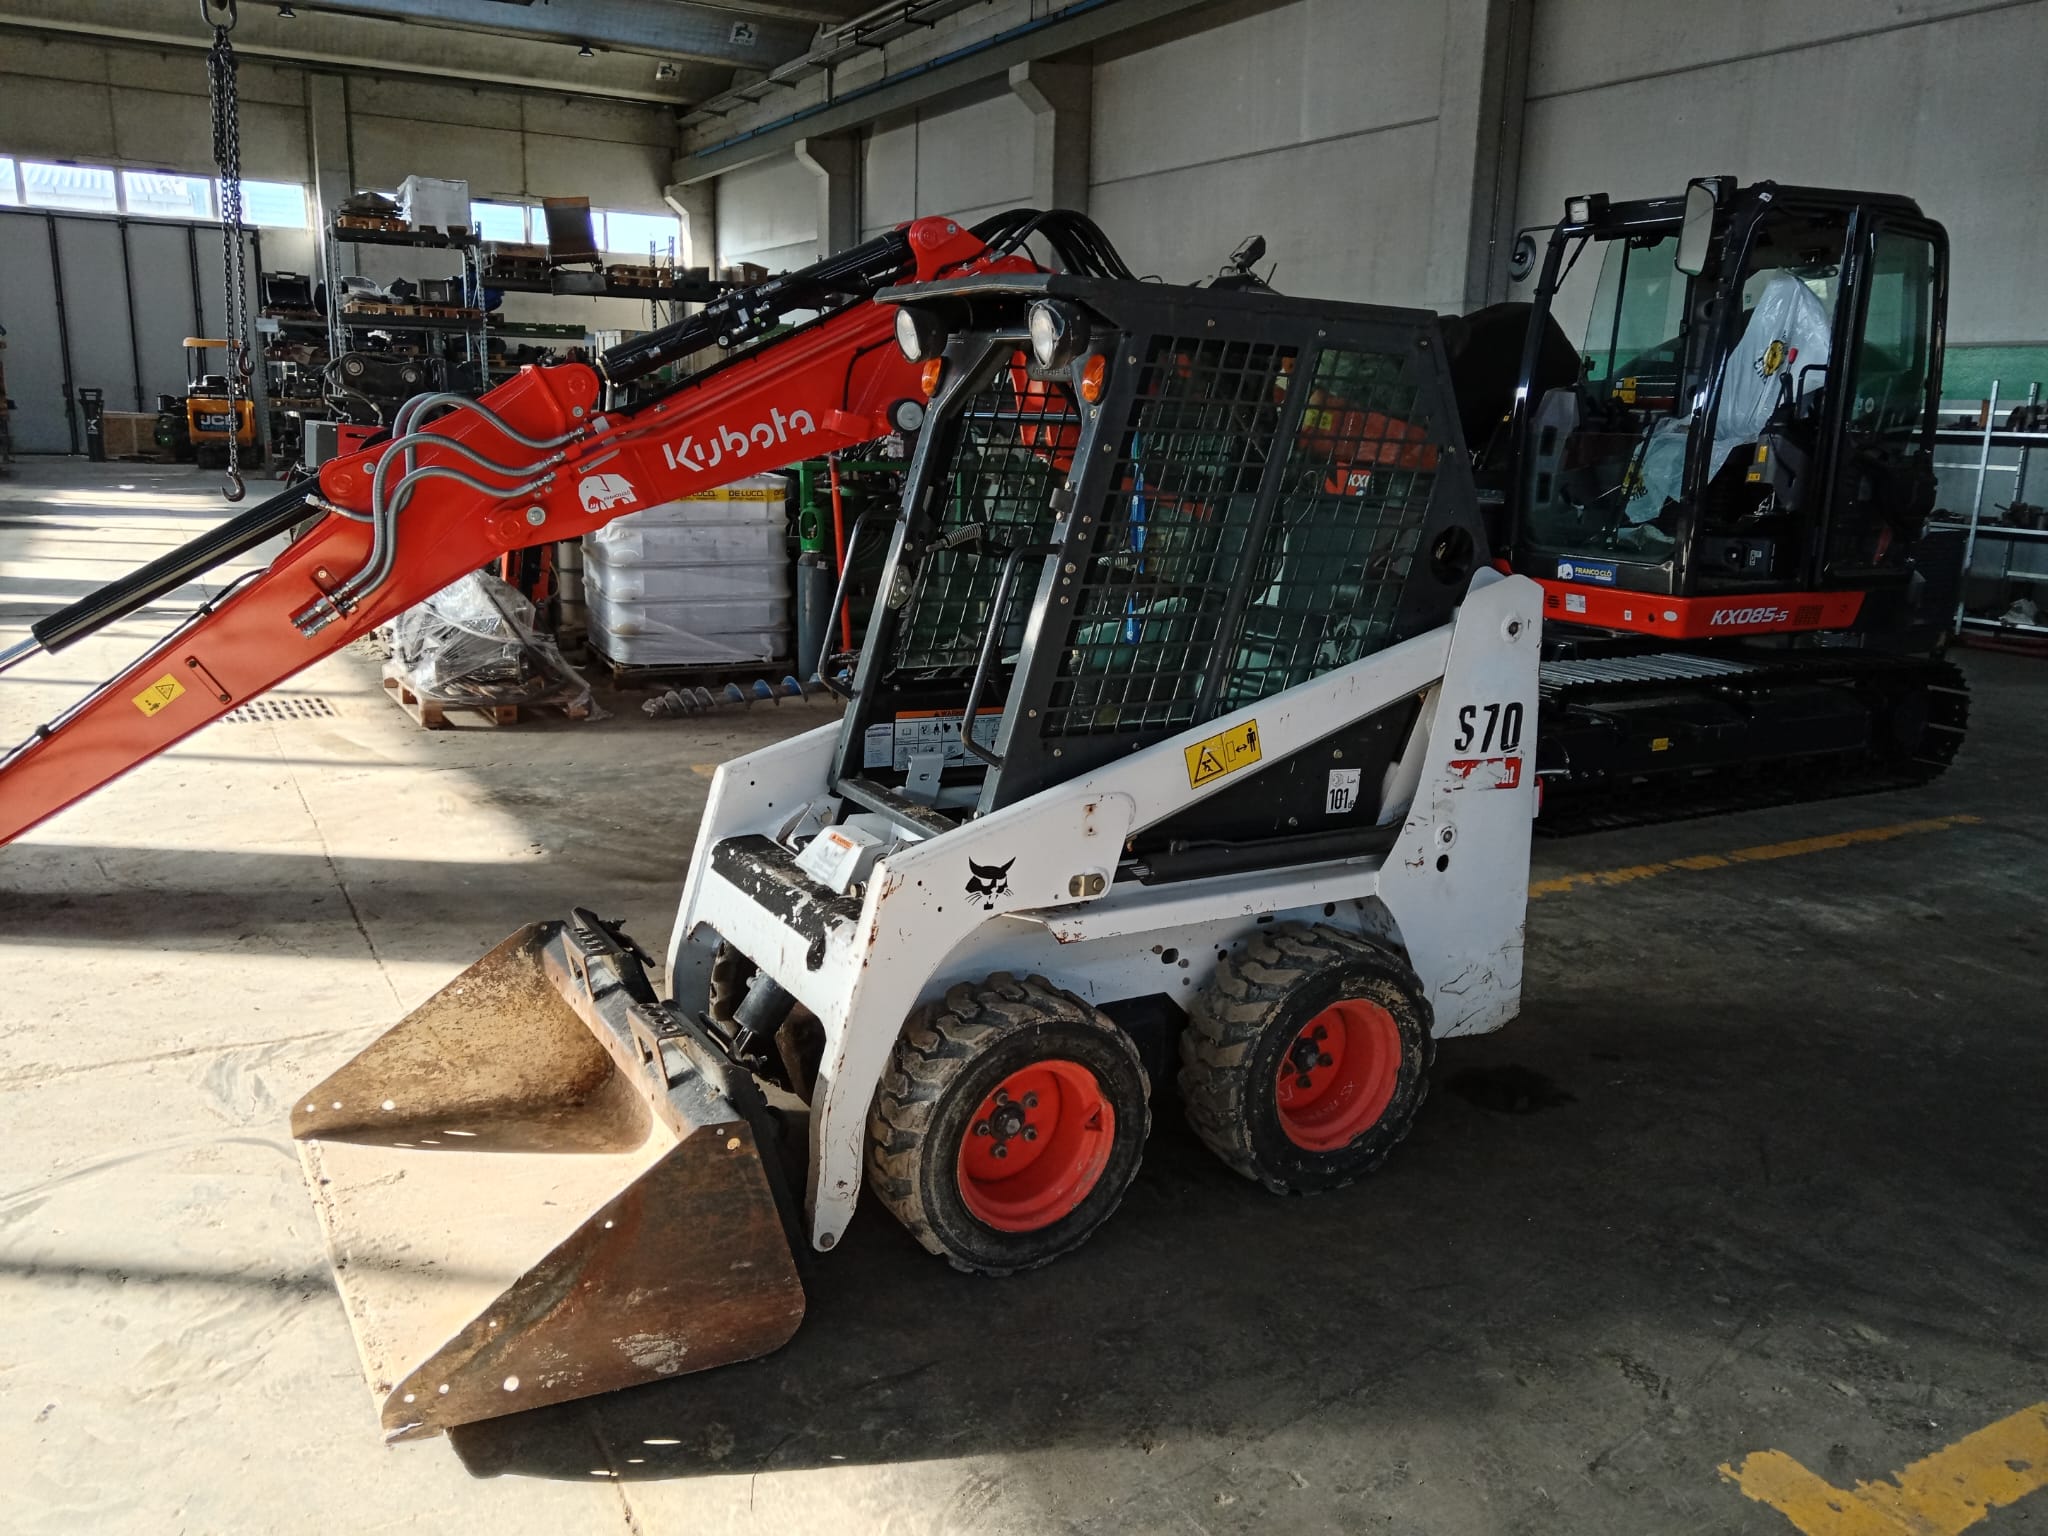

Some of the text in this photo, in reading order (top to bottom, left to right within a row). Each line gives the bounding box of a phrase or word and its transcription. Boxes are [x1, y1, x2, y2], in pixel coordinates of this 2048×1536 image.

[662, 408, 815, 472] Kubota
[1574, 566, 1600, 576] FRANCO
[1710, 607, 1789, 625] KX085-5
[1454, 702, 1524, 753] S70
[1330, 788, 1349, 810] 101
